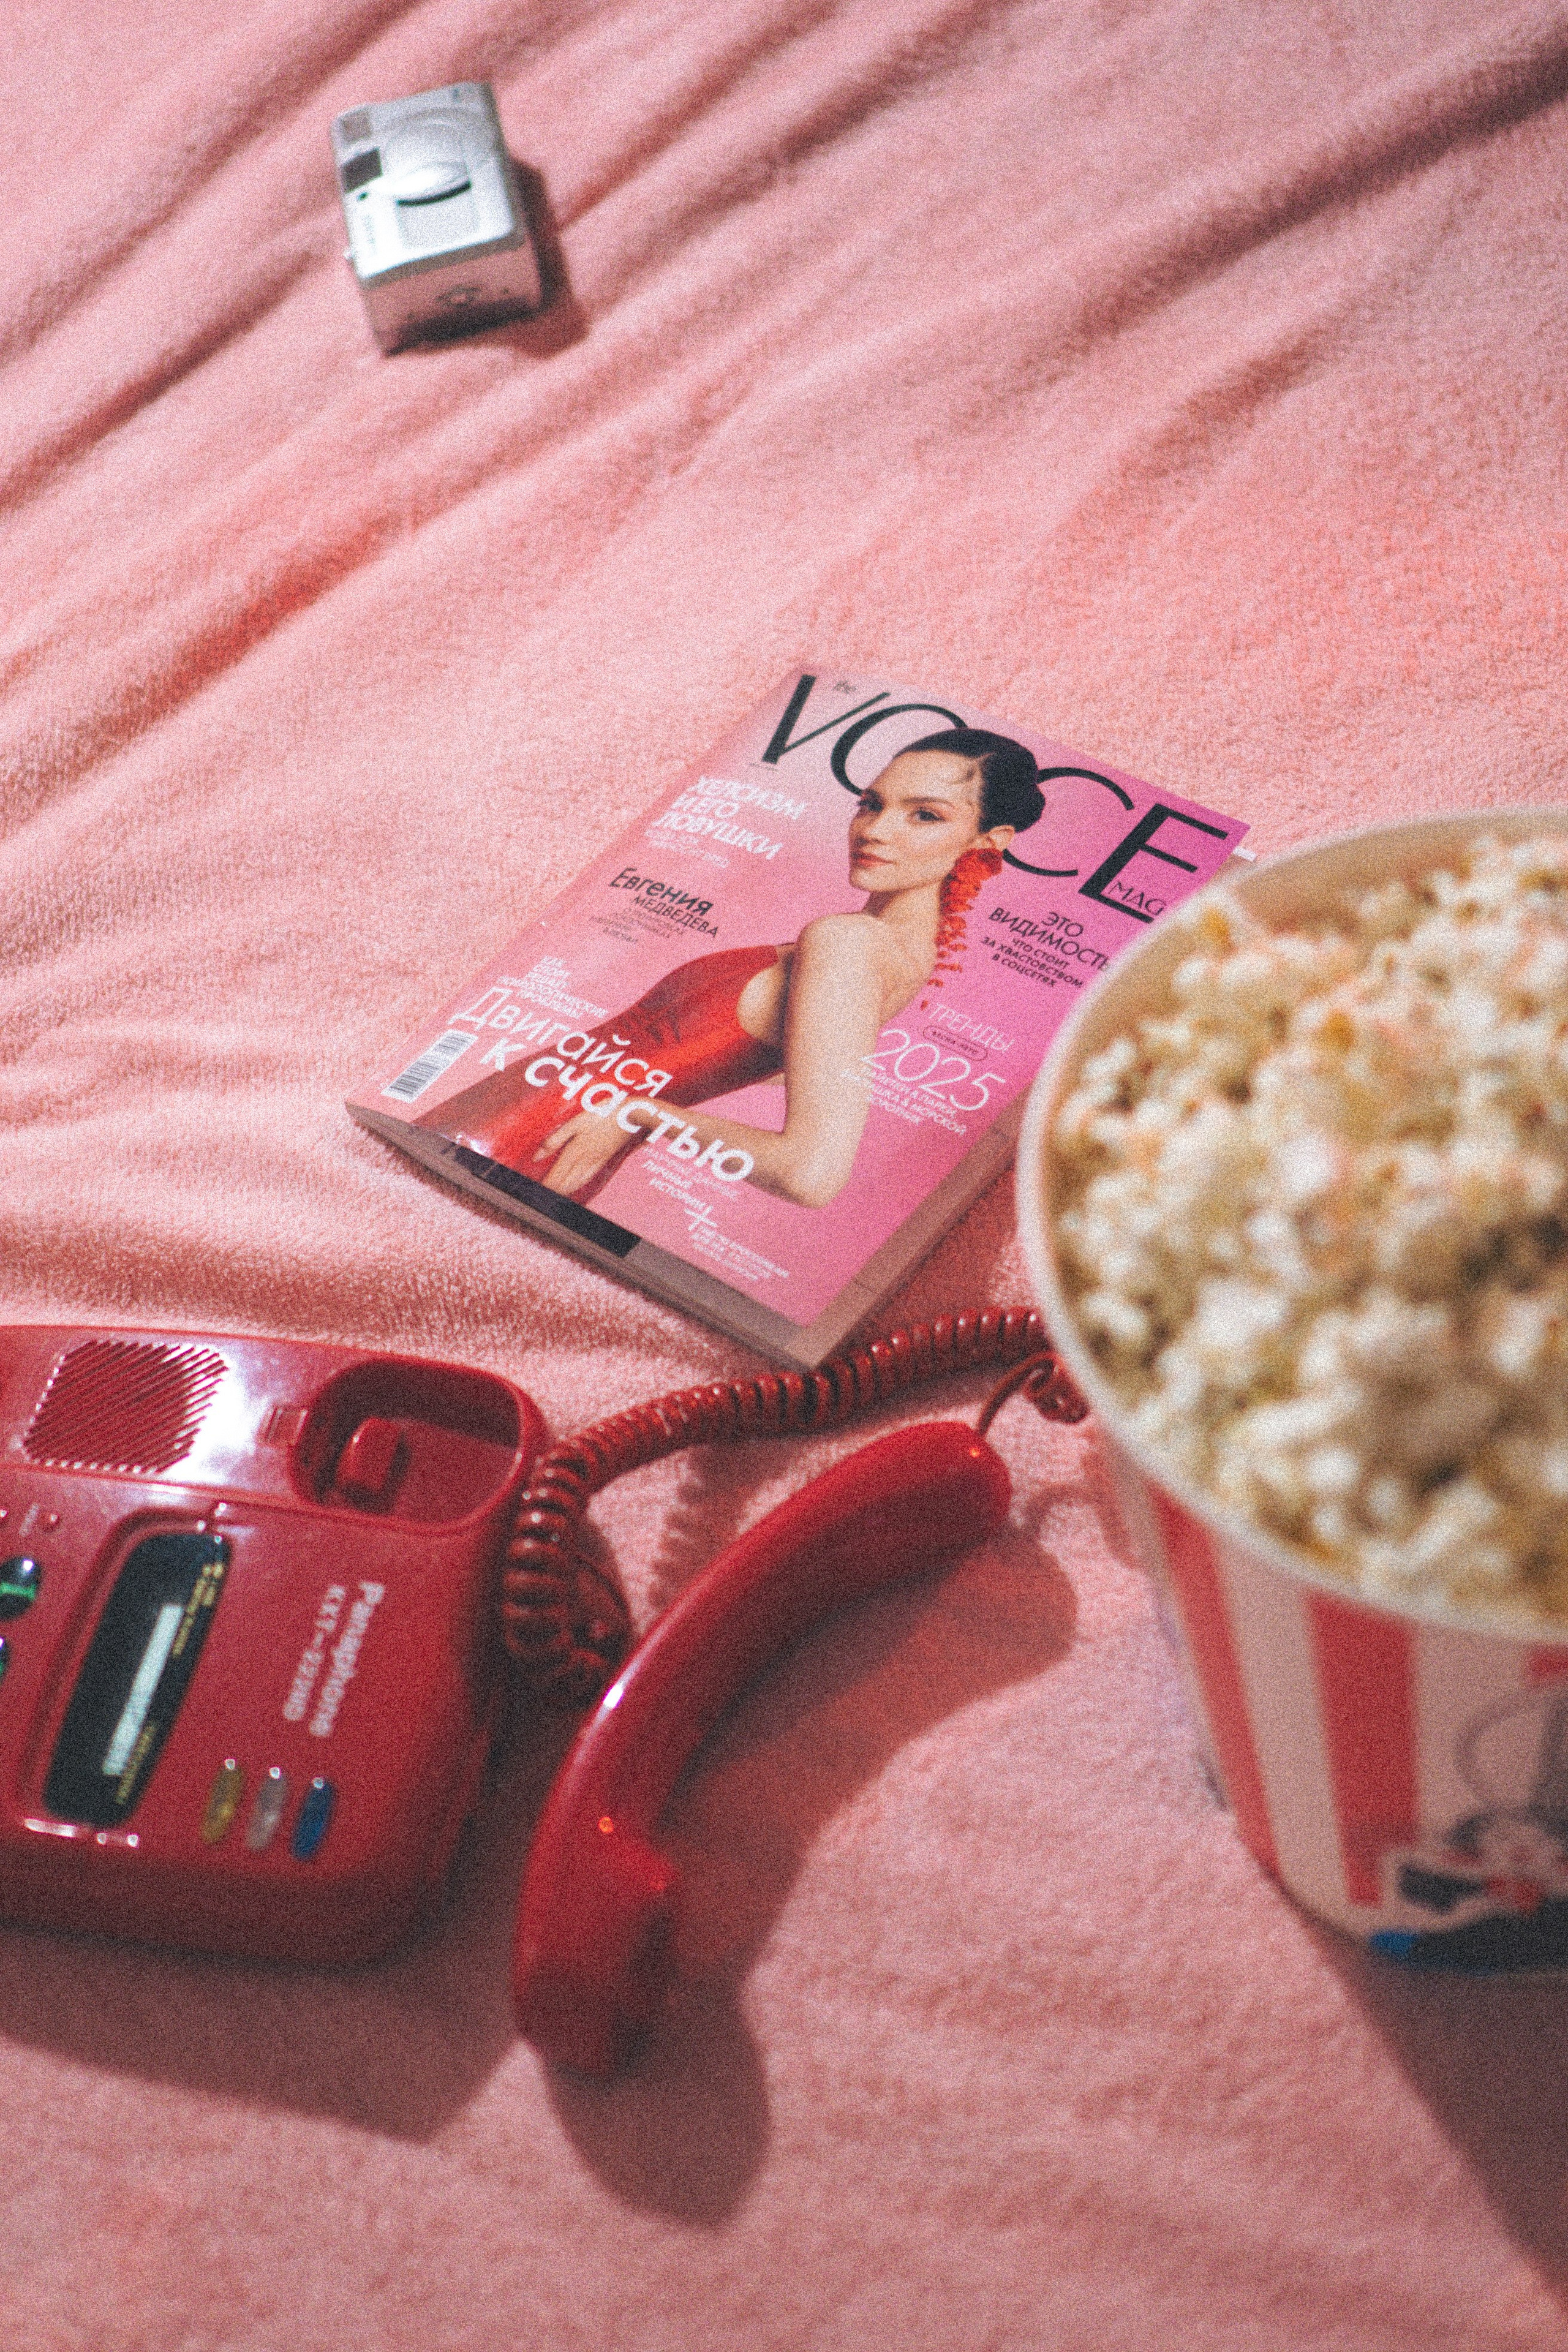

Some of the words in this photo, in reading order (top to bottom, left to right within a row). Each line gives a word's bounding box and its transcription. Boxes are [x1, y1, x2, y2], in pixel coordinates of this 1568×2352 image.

[672, 794, 696, 812] И
[692, 797, 741, 819] ЕГО
[763, 674, 1229, 924] VOCE
[651, 810, 784, 861] ЛОВУШКИ
[609, 866, 714, 916] Евгения
[633, 895, 719, 938] МЕДВЕДЕВА
[1041, 911, 1084, 938] ЭТО
[981, 936, 997, 948] ЗА
[998, 943, 1084, 987] ХВАСТОВСТВОМ
[1001, 957, 1057, 988] СОЦСЕТЯХ
[1012, 938, 1033, 952] ЧТО
[1033, 948, 1071, 970] СТОИТ
[447, 986, 673, 1098] Двигайся
[929, 1004, 1016, 1052] ТРЕНДЫ
[859, 1028, 1006, 1111] 2025
[524, 1056, 755, 1183] счастью
[911, 1104, 967, 1136] МОРСКОЙ
[309, 1580, 385, 1737] Panaphone
